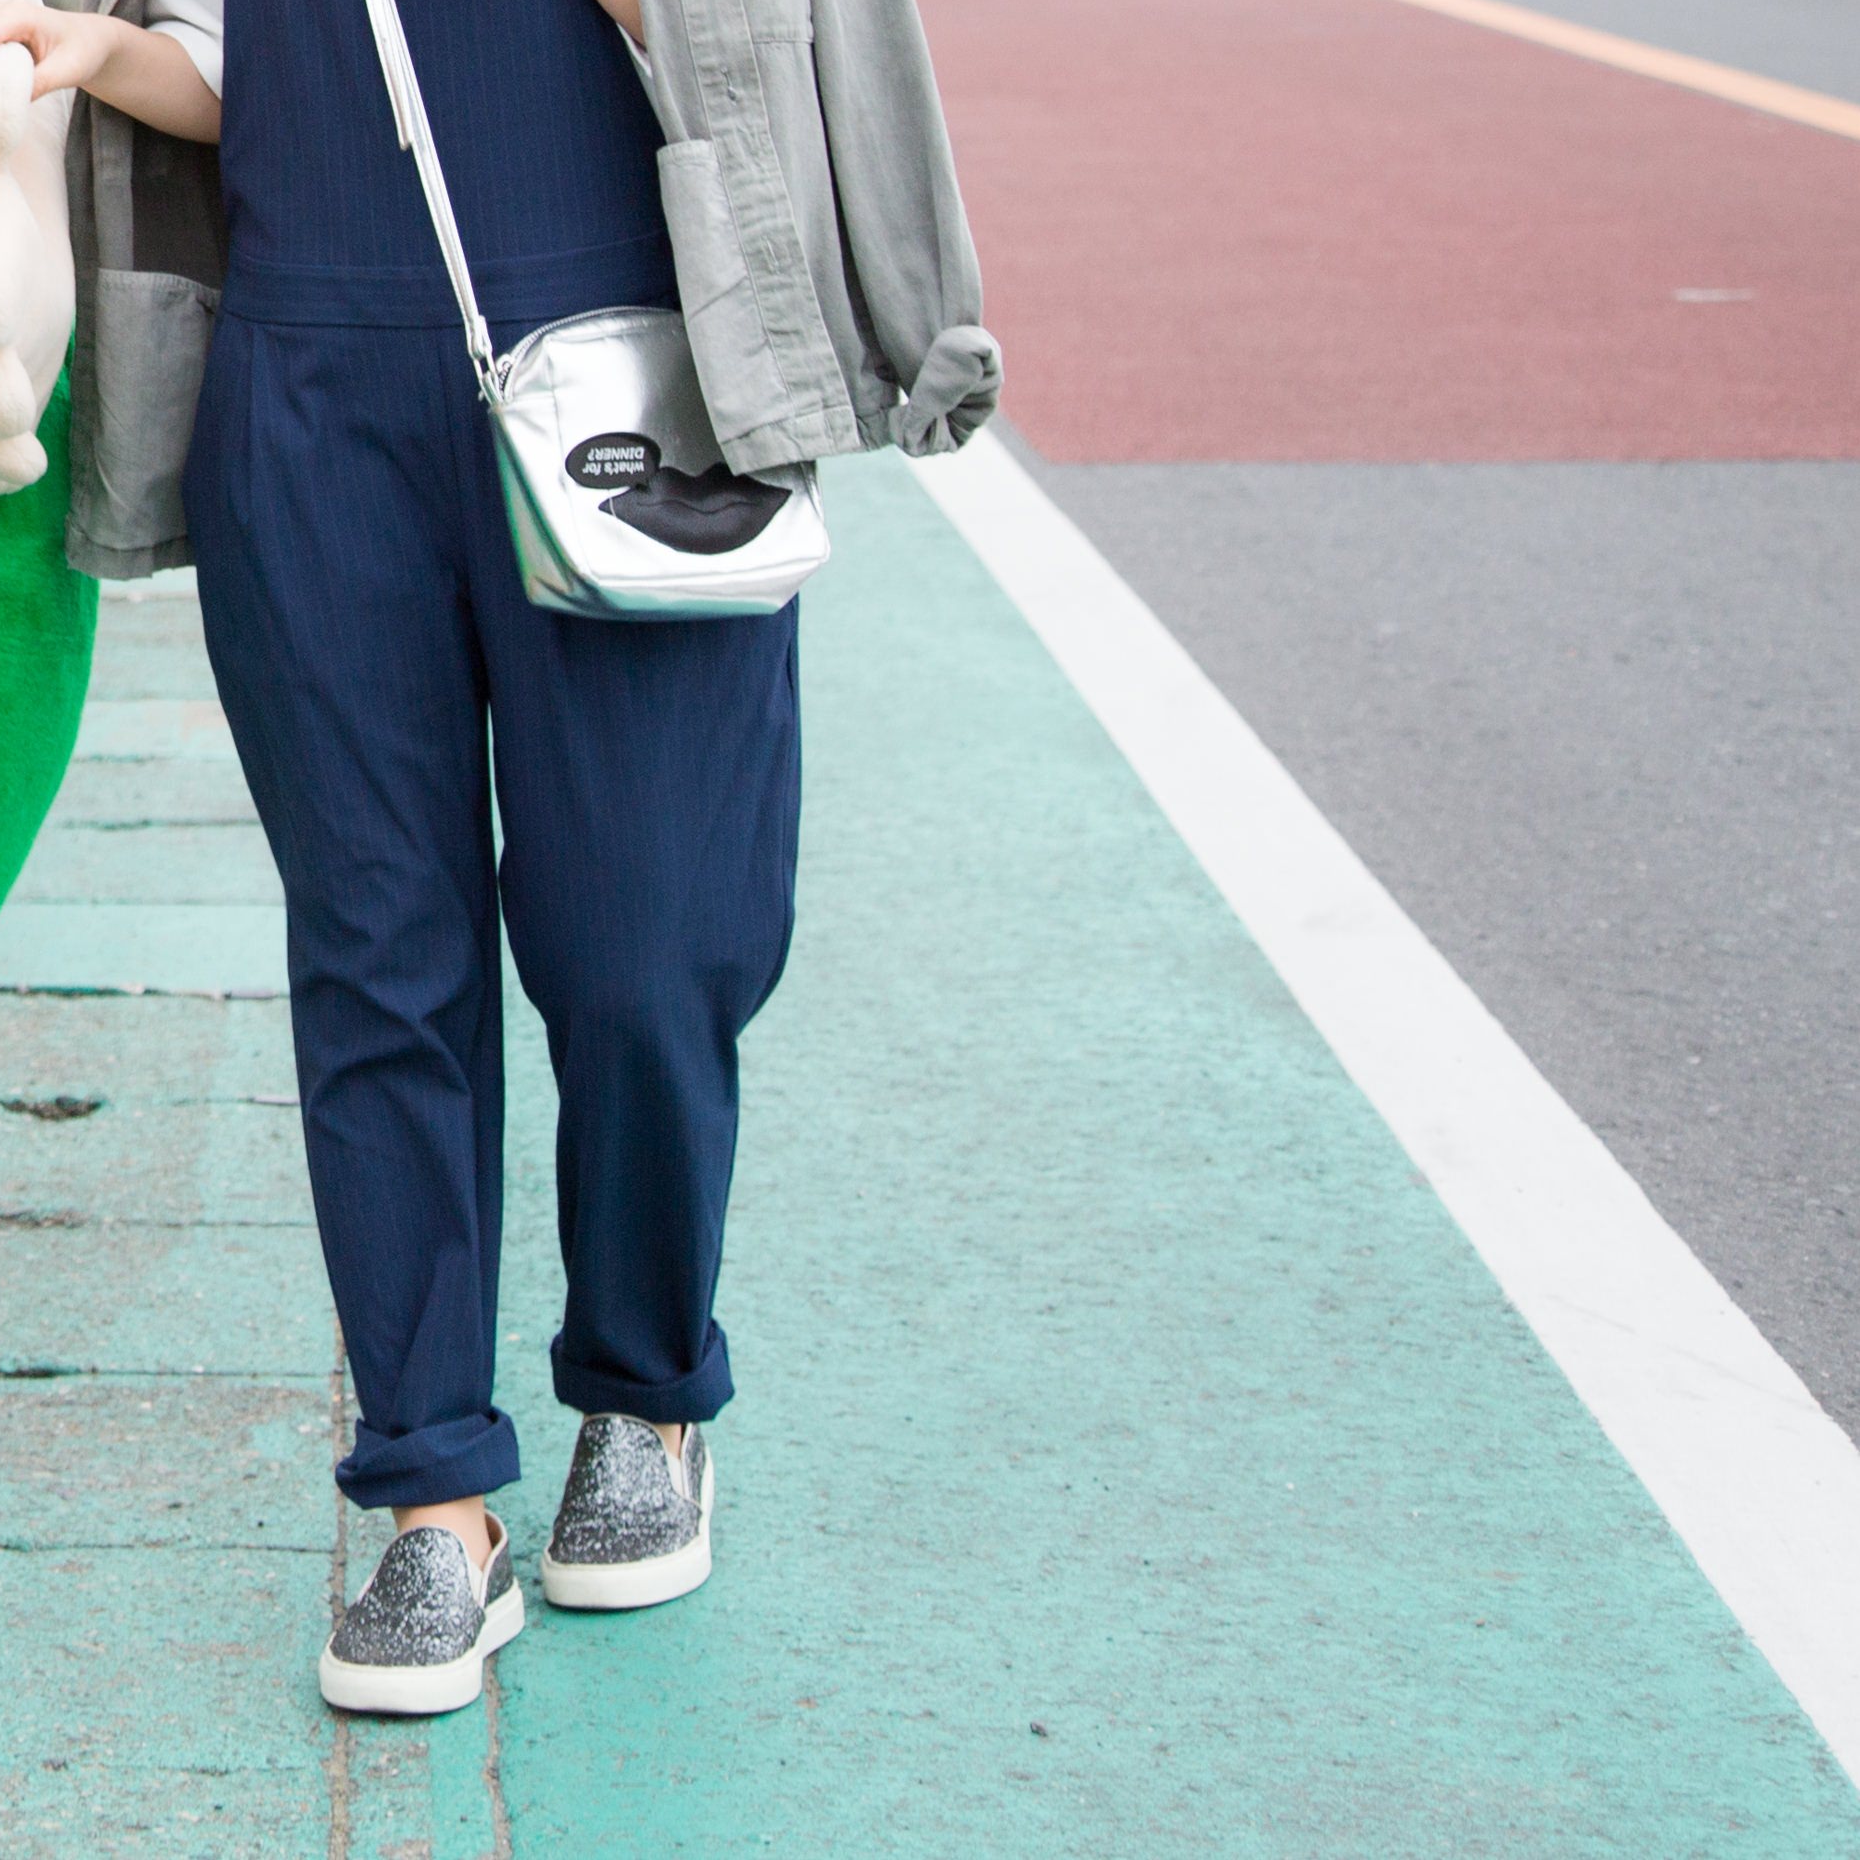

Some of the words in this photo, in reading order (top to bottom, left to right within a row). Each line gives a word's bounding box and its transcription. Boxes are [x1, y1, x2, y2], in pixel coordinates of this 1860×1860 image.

[588, 447, 644, 461] DINNER?
[583, 463, 601, 475] for
[604, 461, 644, 475] what's
